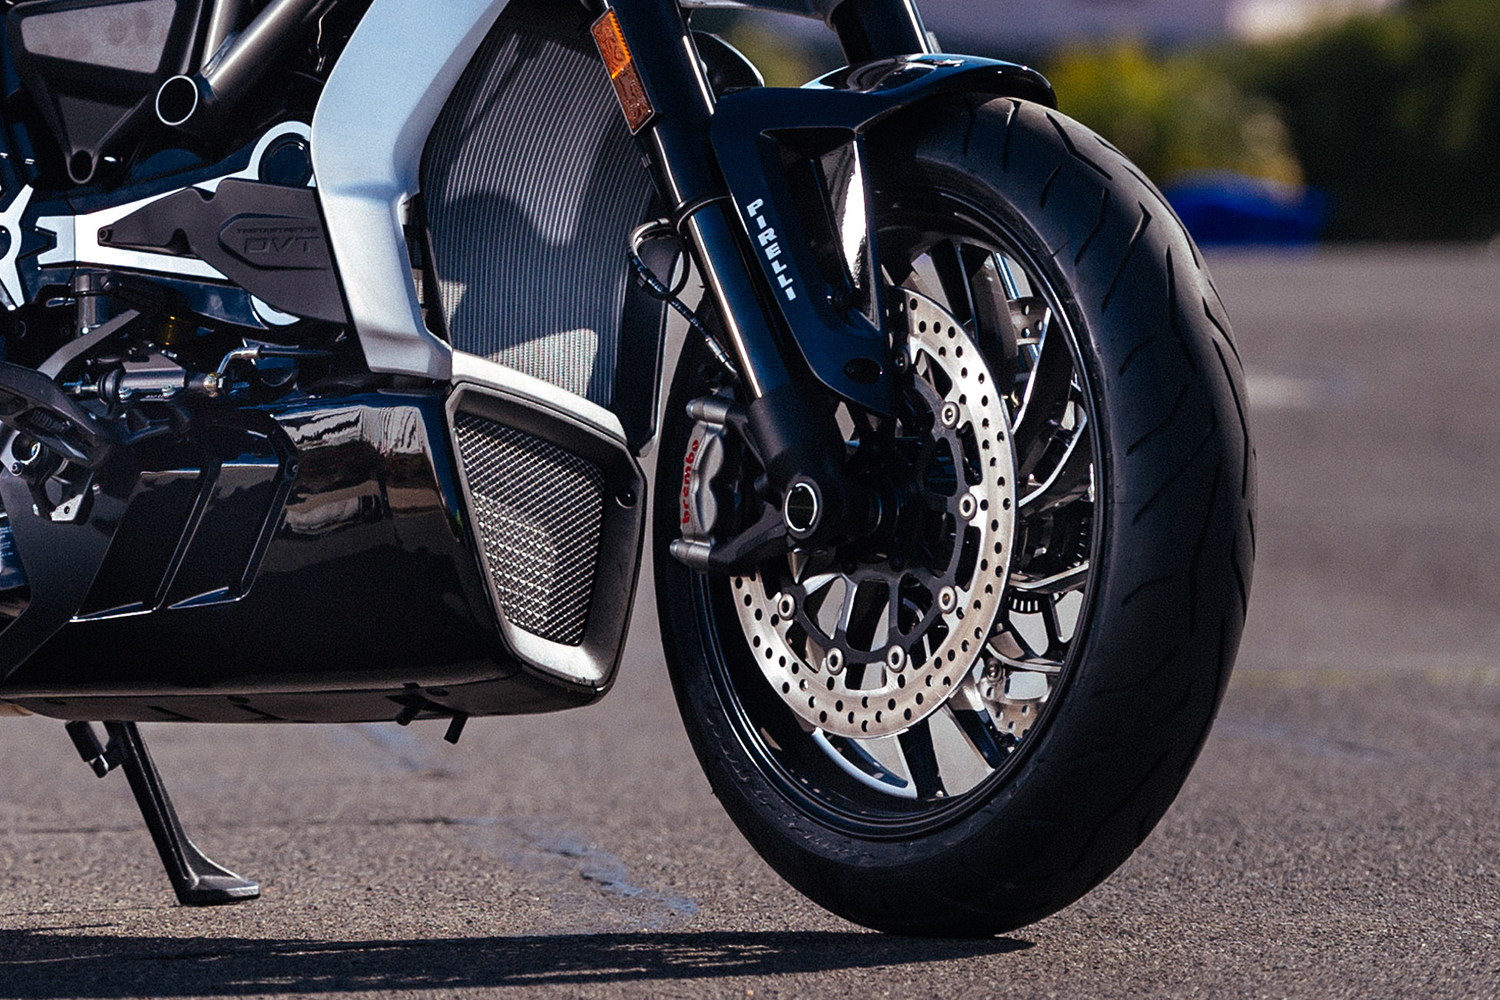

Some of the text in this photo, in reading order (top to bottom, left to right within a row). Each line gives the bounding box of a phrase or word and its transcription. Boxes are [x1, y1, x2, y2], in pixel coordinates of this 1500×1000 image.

[243, 236, 321, 253] DVT
[746, 198, 796, 301] PIRELLI
[682, 439, 699, 524] brembo
